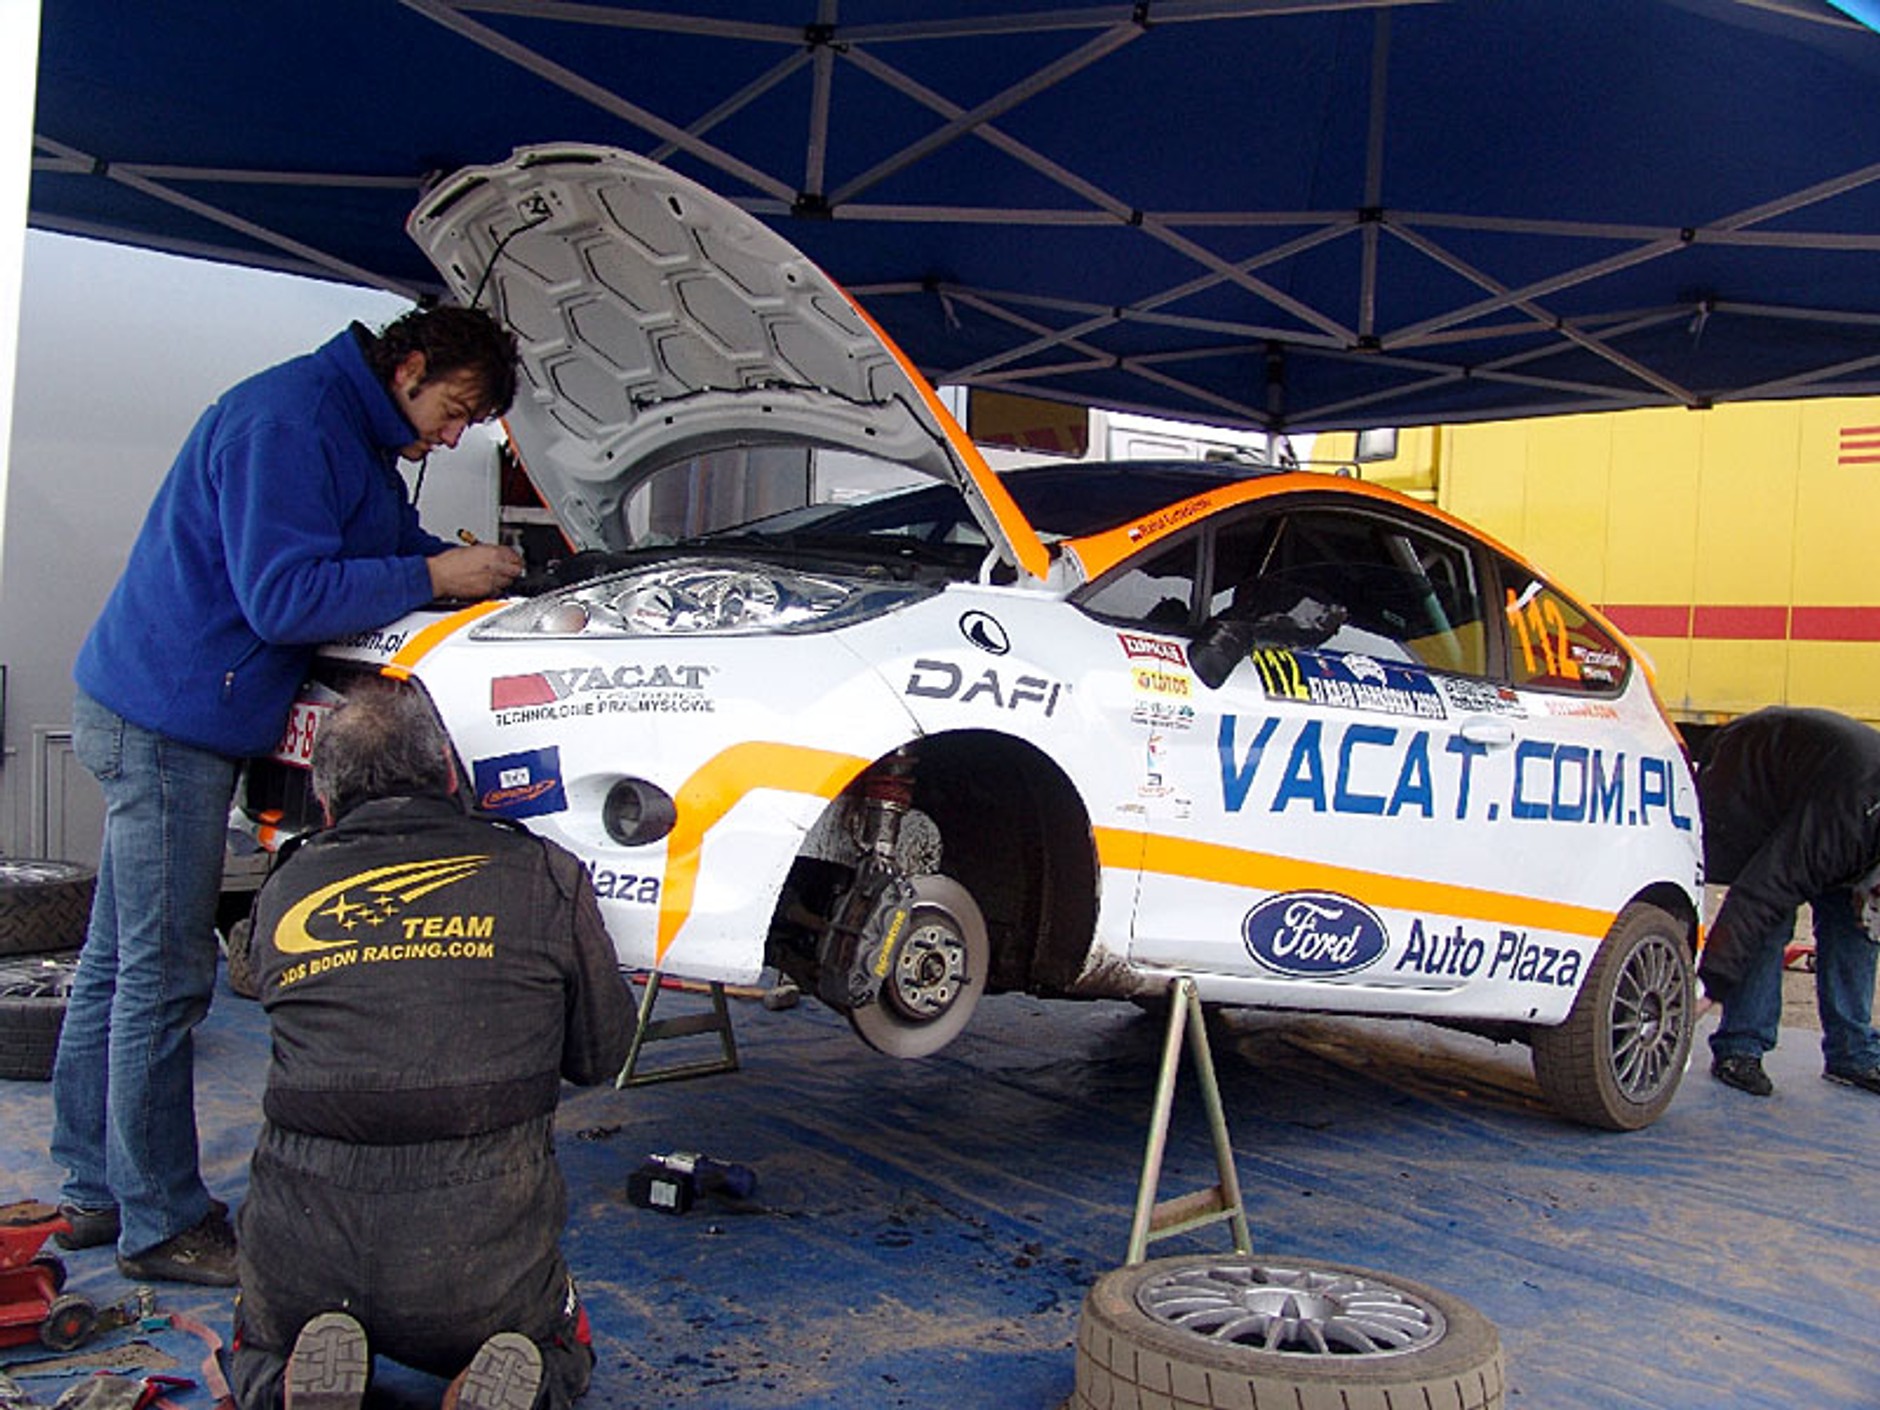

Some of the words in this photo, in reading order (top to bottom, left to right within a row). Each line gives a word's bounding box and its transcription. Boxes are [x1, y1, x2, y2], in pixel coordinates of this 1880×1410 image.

[1506, 587, 1580, 680] 112
[543, 665, 711, 700] VACAT
[905, 659, 1061, 718] DAFI
[1253, 649, 1310, 700] 112
[1217, 714, 1692, 831] VACAT.COM.PL
[362, 942, 494, 964] RACING.COM
[402, 916, 496, 940] TEAM
[1272, 900, 1360, 963] Ford
[1396, 919, 1484, 978] Auto
[1488, 930, 1582, 987] Plaza
